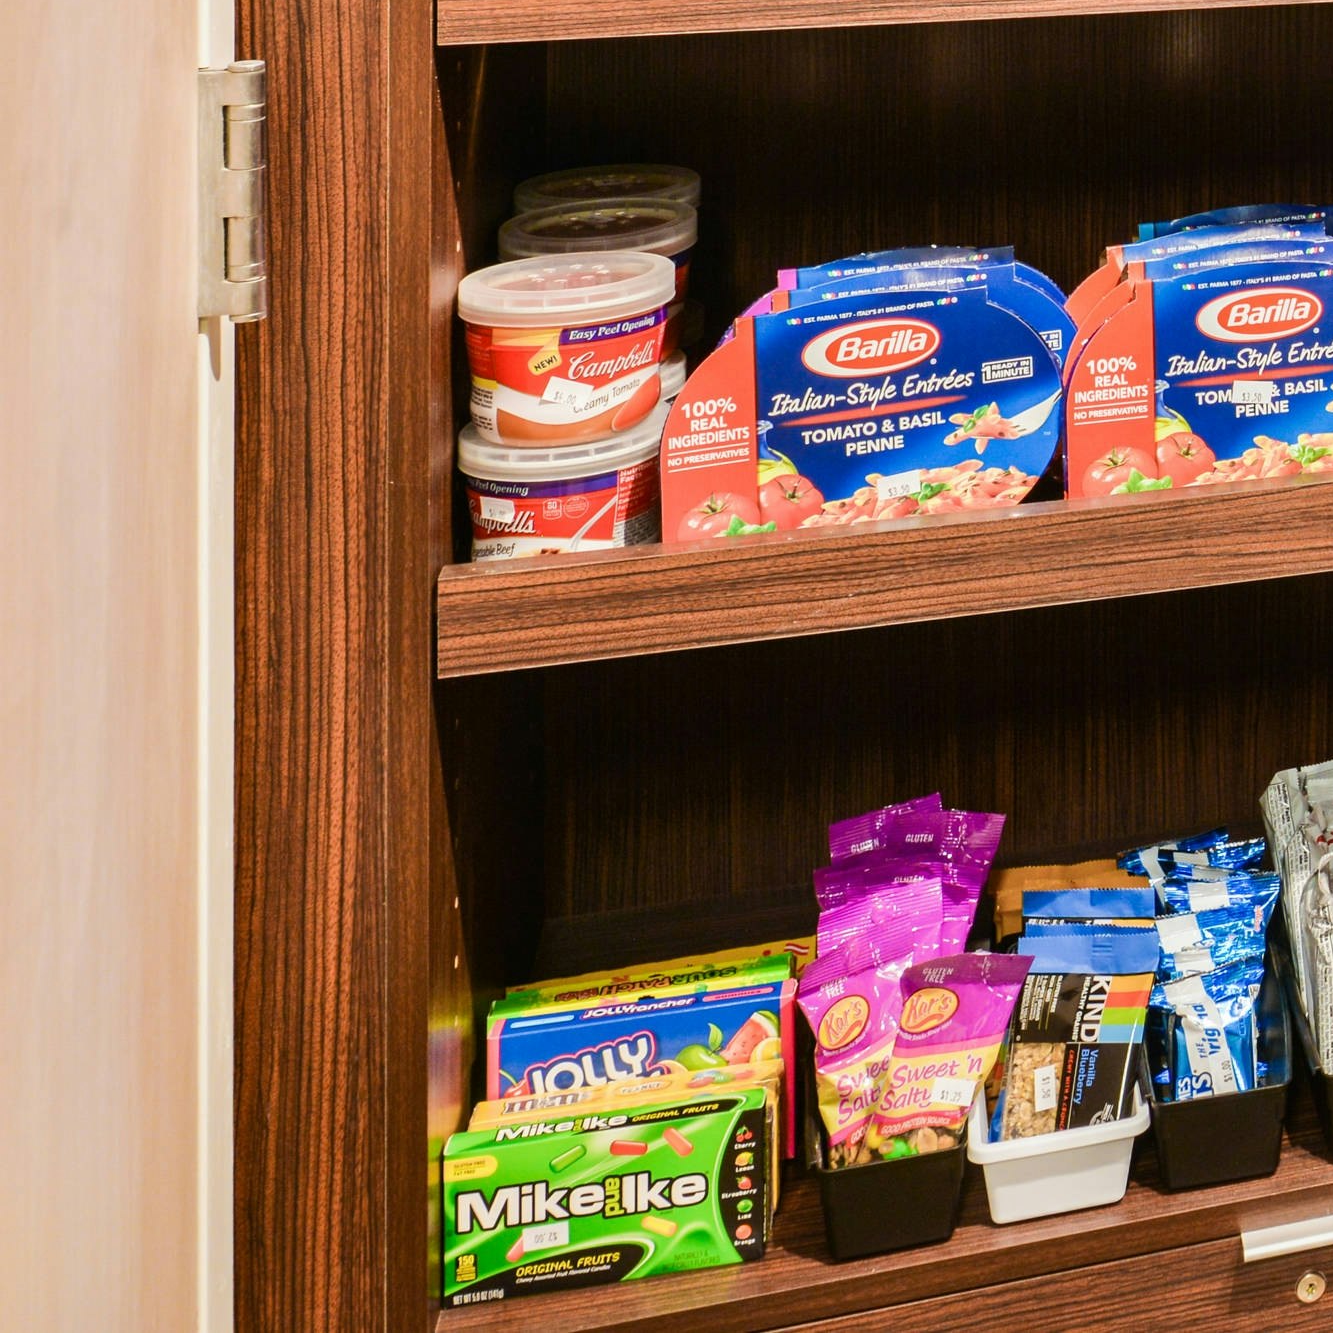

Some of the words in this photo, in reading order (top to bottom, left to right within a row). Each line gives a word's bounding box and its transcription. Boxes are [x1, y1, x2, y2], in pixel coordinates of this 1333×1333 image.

[1227, 298, 1311, 327] Barilla
[569, 327, 596, 340] Easy
[598, 324, 619, 337] Peel
[621, 314, 655, 335] Opening
[836, 329, 928, 362] Barilla
[533, 357, 557, 371] NEW!
[569, 340, 655, 380] Campbell's
[1086, 356, 1136, 374] 100%
[1166, 343, 1282, 378] Italian-Style
[992, 366, 1030, 379] MINUTE
[1095, 373, 1127, 387] REAL
[768, 375, 897, 416] Italian-Style
[902, 370, 974, 397] Entrées
[1074, 385, 1148, 403] INGREDIENTS
[1284, 378, 1327, 394] BASIL
[681, 397, 736, 418] 100%
[1074, 411, 1086, 419] NO
[1088, 405, 1148, 418] PRESERVATIVES
[1235, 400, 1289, 418] PENNE
[690, 416, 727, 432] REAL
[668, 427, 749, 449] INGREDIENTS
[845, 436, 905, 456] PENNE
[667, 458, 680, 467] NO
[683, 448, 749, 464] PRESERVATIVES
[490, 484, 529, 495] Opening
[906, 834, 933, 843] GLUTEN
[924, 972, 947, 984] FREE
[826, 985, 845, 997] FREE
[904, 989, 954, 1021] Kar's
[1080, 976, 1112, 1043] KIND
[526, 1036, 652, 1094] JOLLY
[1086, 1049, 1099, 1087] Vanilla
[1073, 1049, 1090, 1104] Blueberry
[632, 1108, 681, 1123] ORIGINAL
[682, 1103, 719, 1116] FRUITS
[881, 1124, 902, 1136] GOOD
[903, 1119, 927, 1131] PROTEIN
[928, 1116, 951, 1127] SOURCE
[734, 1142, 755, 1150] Cherry
[722, 1188, 757, 1199] Strawberry
[734, 1237, 755, 1246] Orange
[458, 1255, 475, 1266] 150
[516, 1260, 573, 1277] ORIGINAL
[577, 1252, 620, 1269] FRUITS
